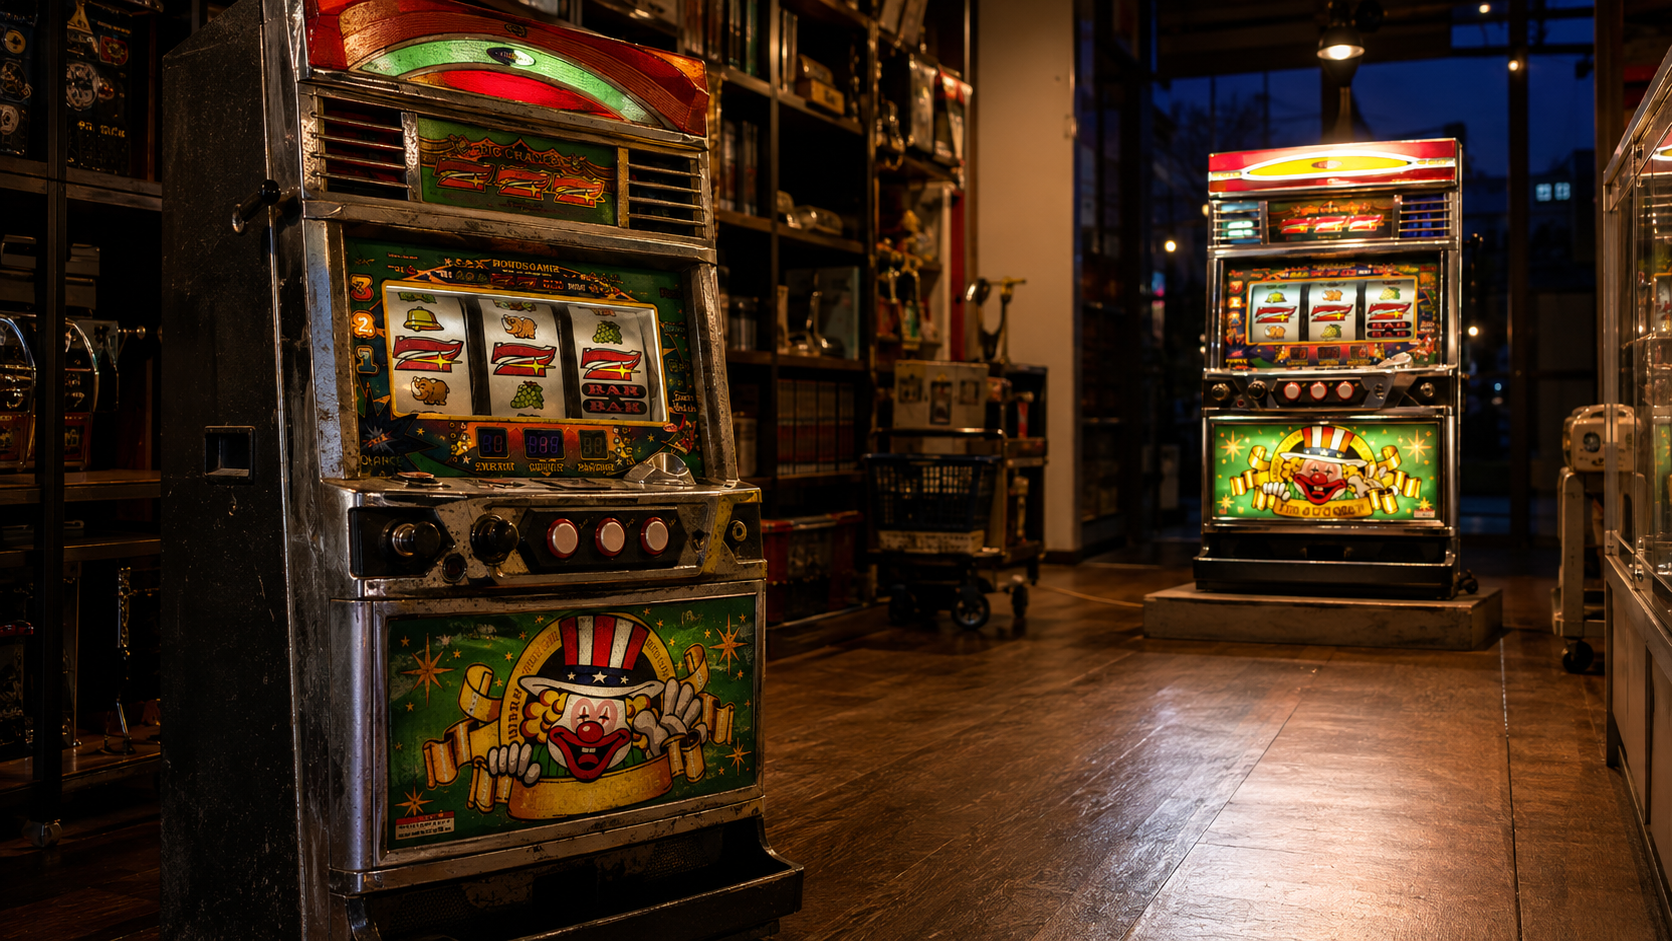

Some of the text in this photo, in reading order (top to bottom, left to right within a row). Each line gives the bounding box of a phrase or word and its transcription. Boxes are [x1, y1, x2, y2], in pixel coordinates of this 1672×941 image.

[349, 274, 374, 302] 3
[355, 344, 378, 374] 1
[588, 384, 639, 397] BAR
[589, 400, 640, 413] BAR
